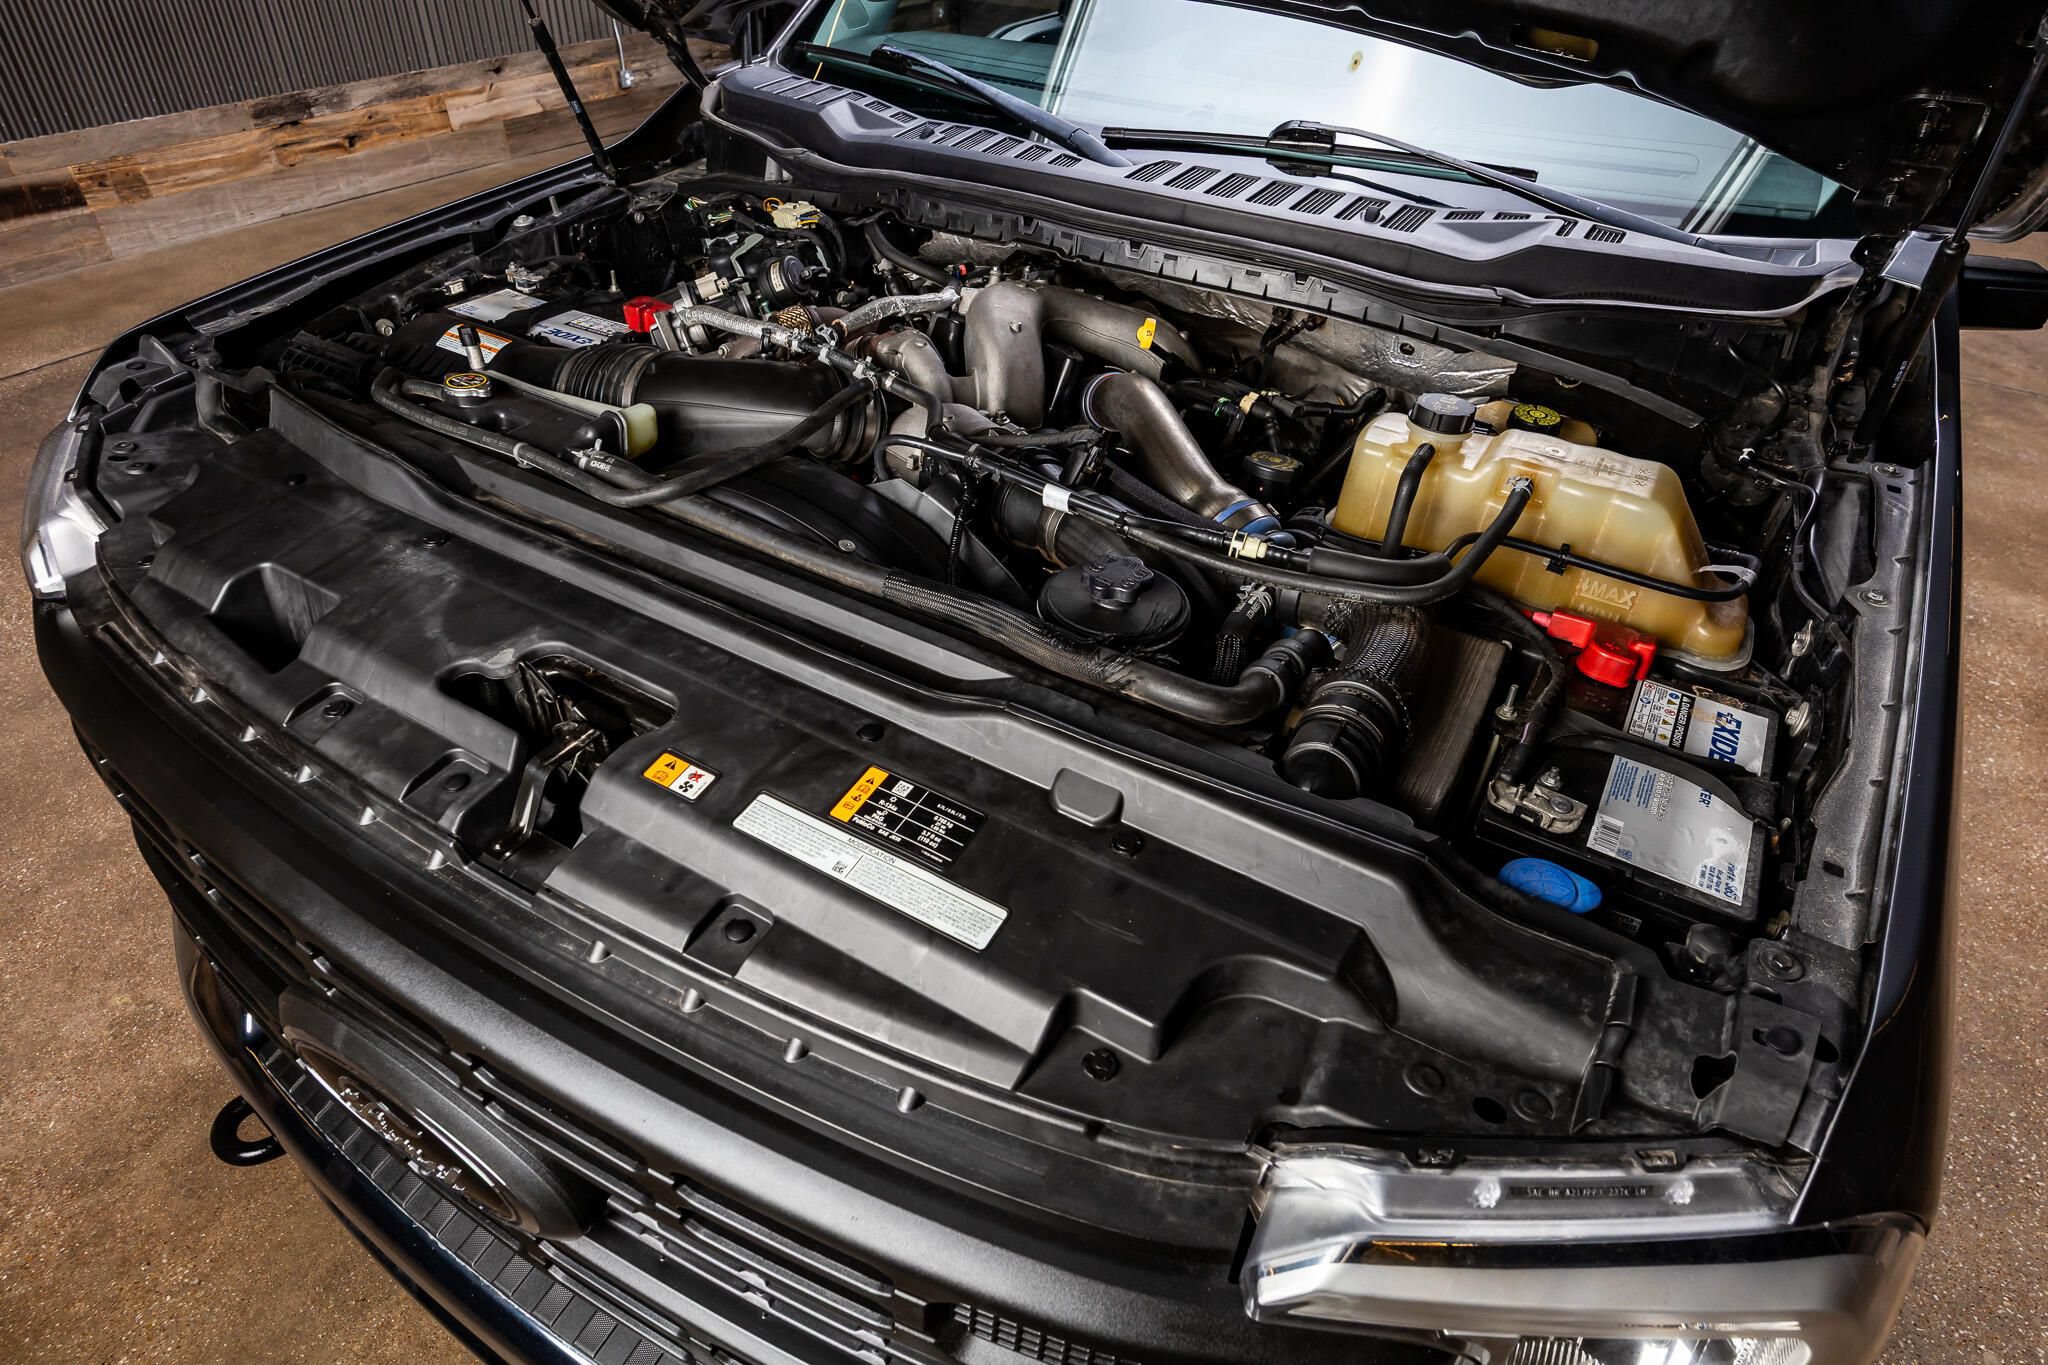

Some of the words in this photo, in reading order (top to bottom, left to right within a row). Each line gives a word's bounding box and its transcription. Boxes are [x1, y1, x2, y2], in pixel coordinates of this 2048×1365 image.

[543, 328, 594, 345] EXIDE
[1591, 580, 1637, 607] MAX
[847, 837, 897, 864] MODIFICATION
